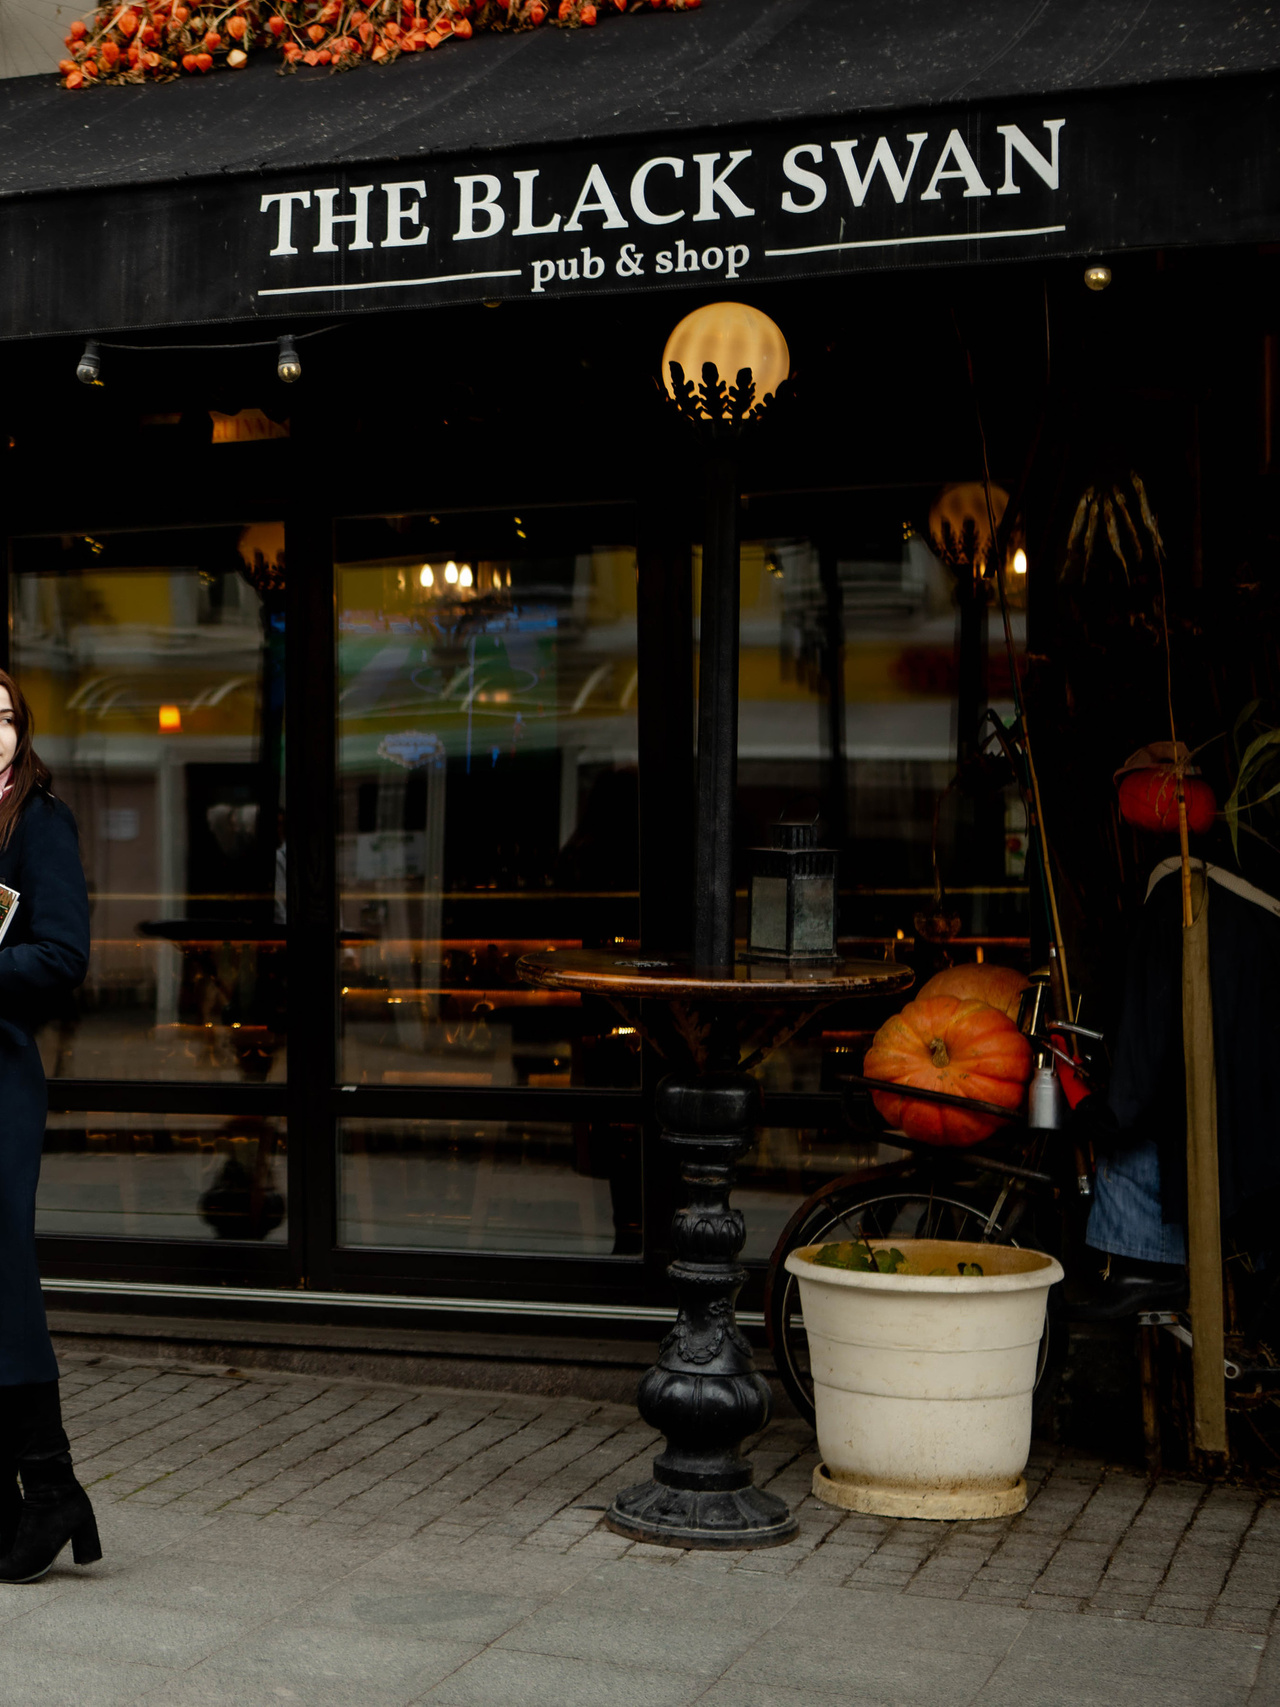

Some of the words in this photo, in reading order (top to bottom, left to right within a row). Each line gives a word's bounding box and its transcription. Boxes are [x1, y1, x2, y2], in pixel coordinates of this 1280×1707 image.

[259, 179, 430, 257] THE
[452, 143, 756, 242] BLACK
[781, 118, 1066, 214] SWAN
[530, 246, 605, 293] pub
[615, 243, 645, 277] &
[655, 239, 750, 280] shop
